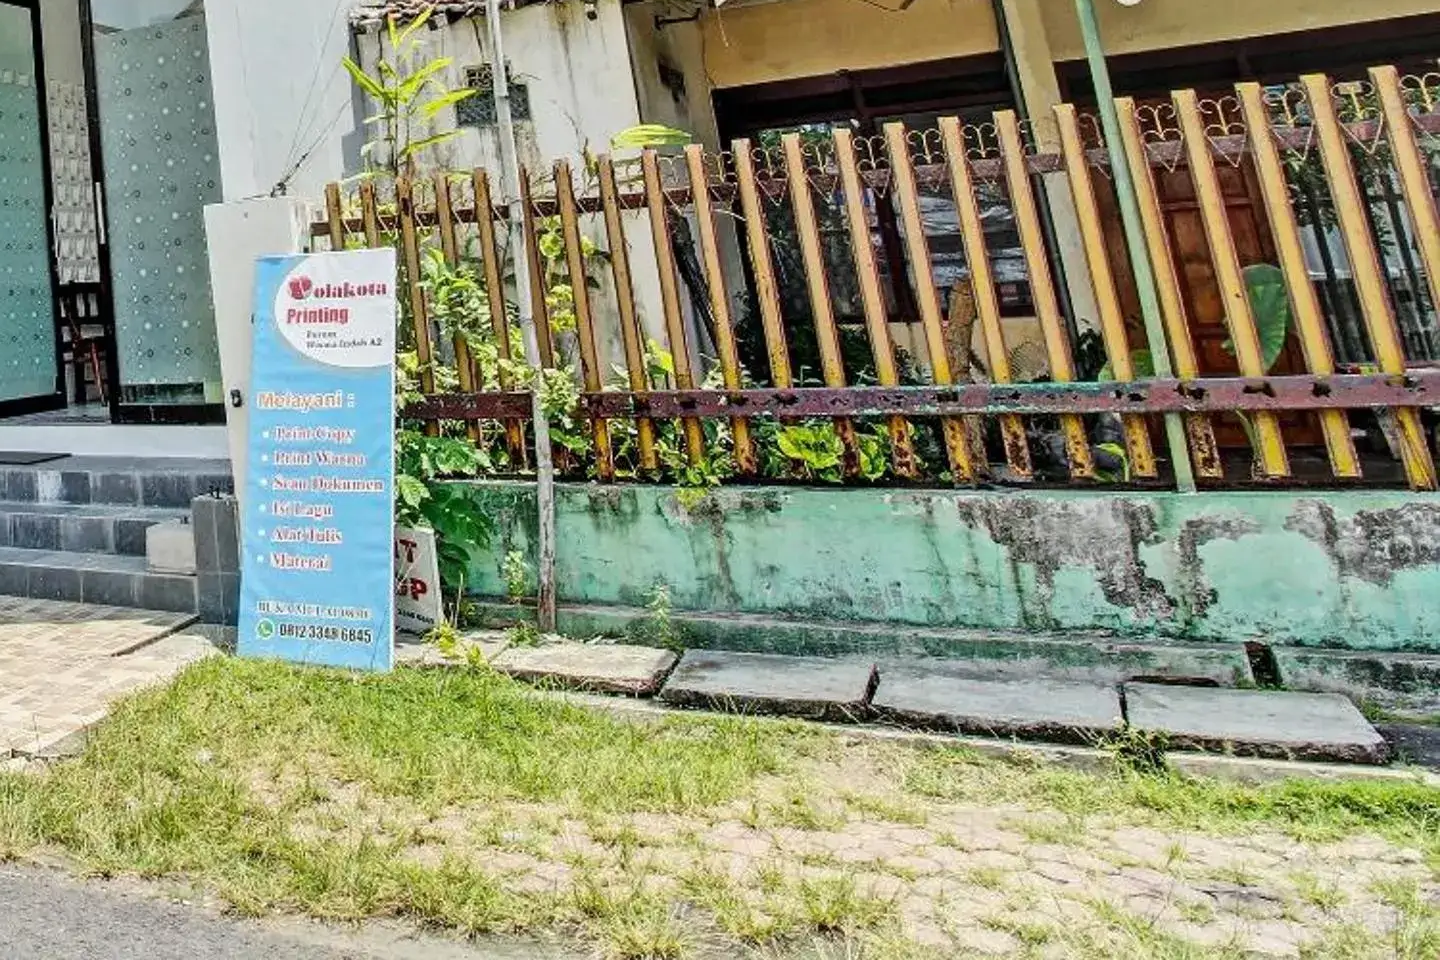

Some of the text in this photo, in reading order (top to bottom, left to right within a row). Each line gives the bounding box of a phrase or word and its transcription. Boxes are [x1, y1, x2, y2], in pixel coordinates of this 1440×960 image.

[287, 308, 349, 325] Printing
[257, 389, 343, 414] Melayani
[272, 474, 385, 493] Scan Dokumen
[280, 623, 307, 638] 0812
[341, 627, 372, 643] 6845
